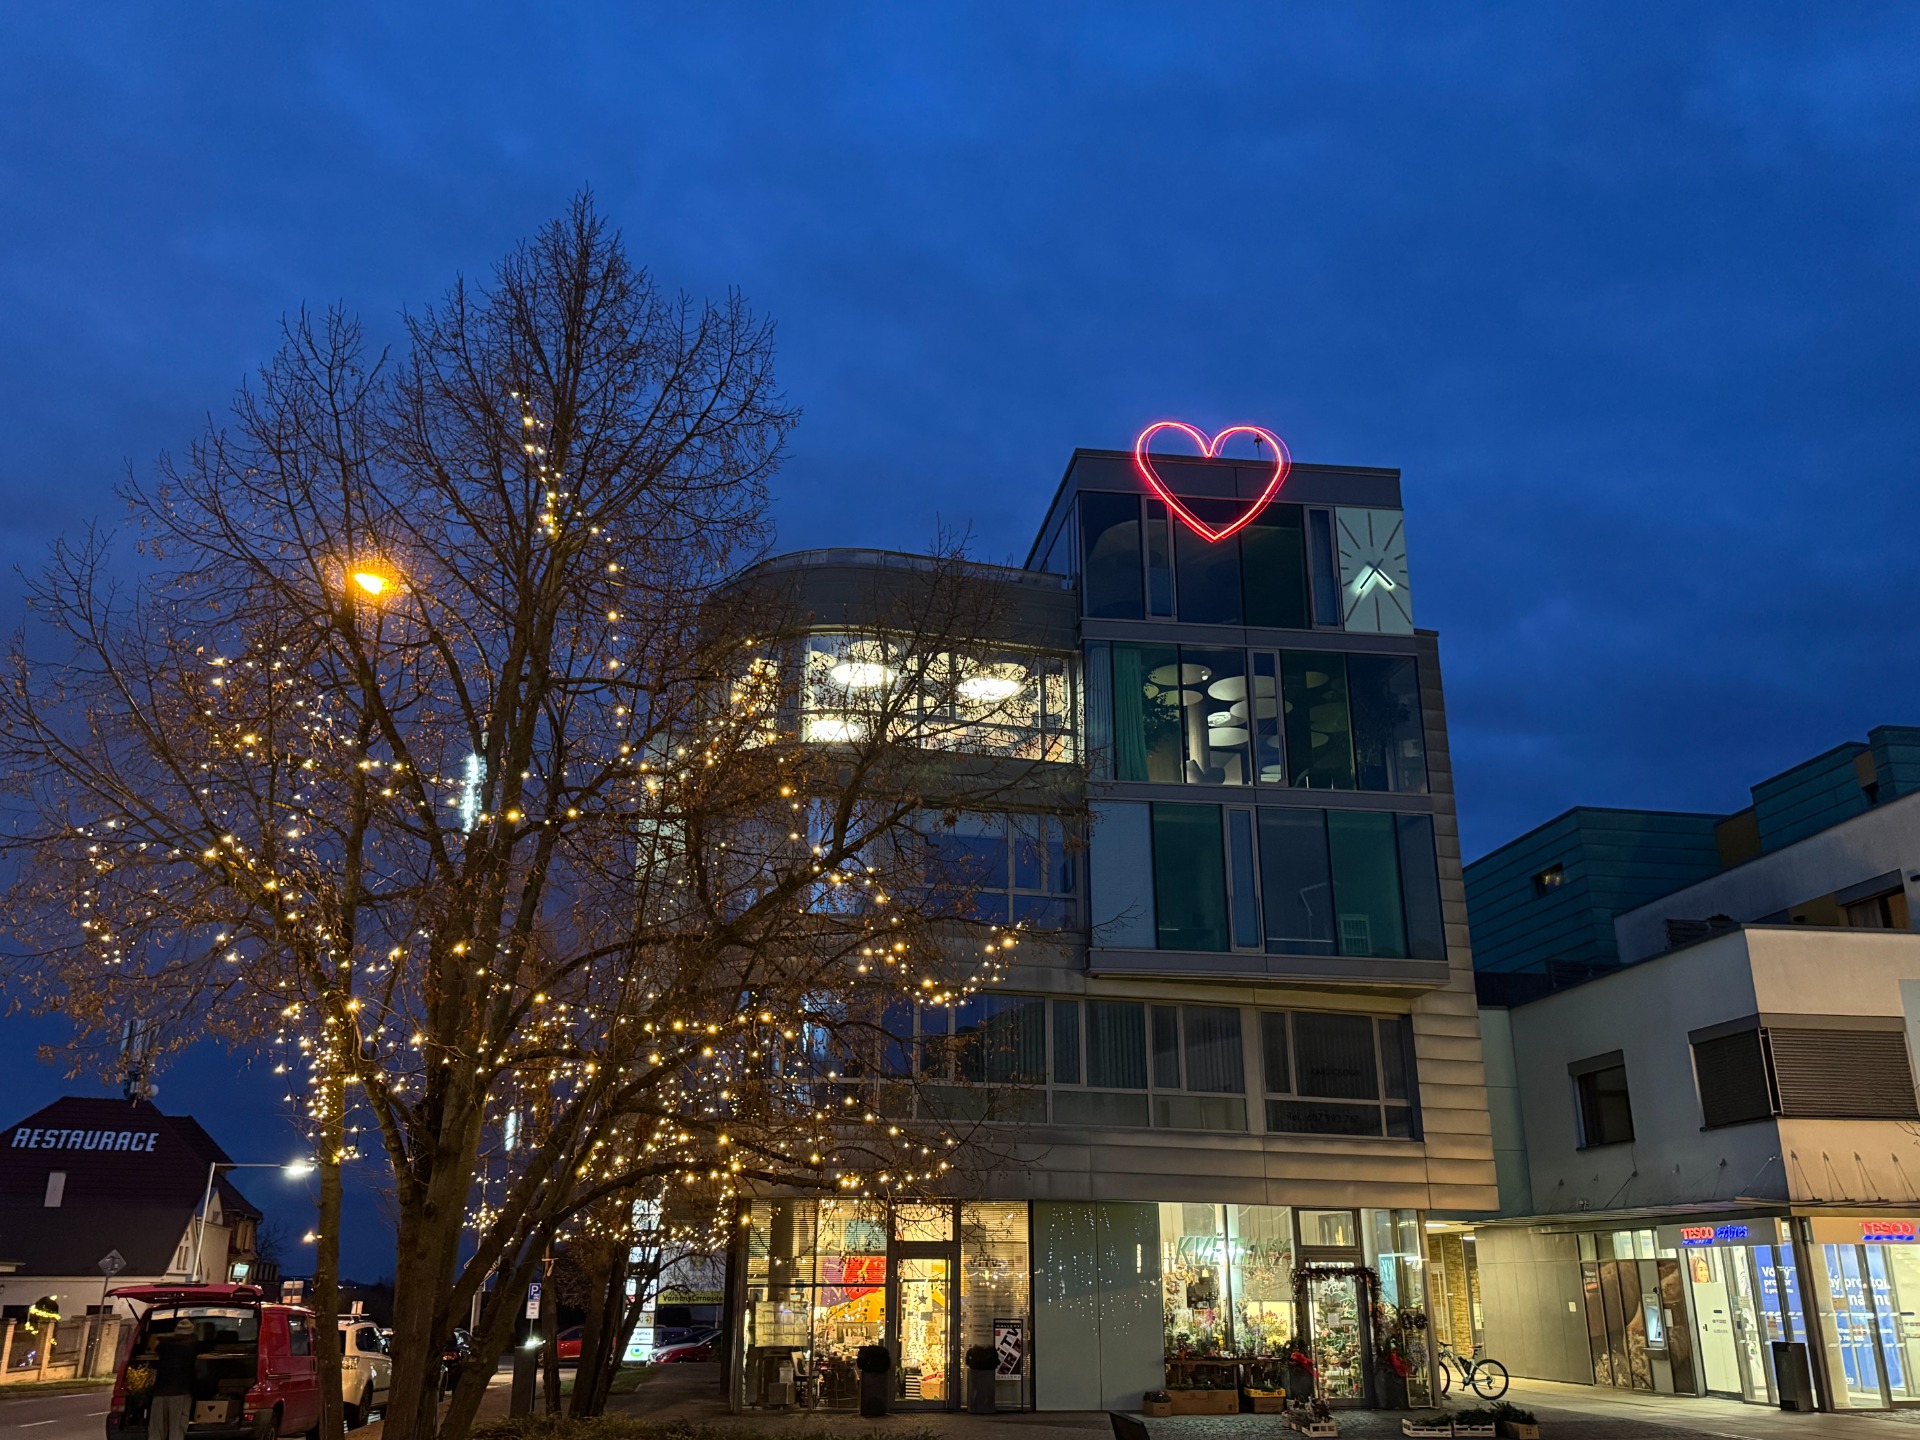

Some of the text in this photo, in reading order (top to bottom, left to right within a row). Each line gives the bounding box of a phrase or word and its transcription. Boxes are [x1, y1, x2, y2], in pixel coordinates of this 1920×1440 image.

[11, 1128, 159, 1152] RESTAURACE
[1680, 1226, 1714, 1240] TESCO
[1859, 1221, 1915, 1236] TESCO
